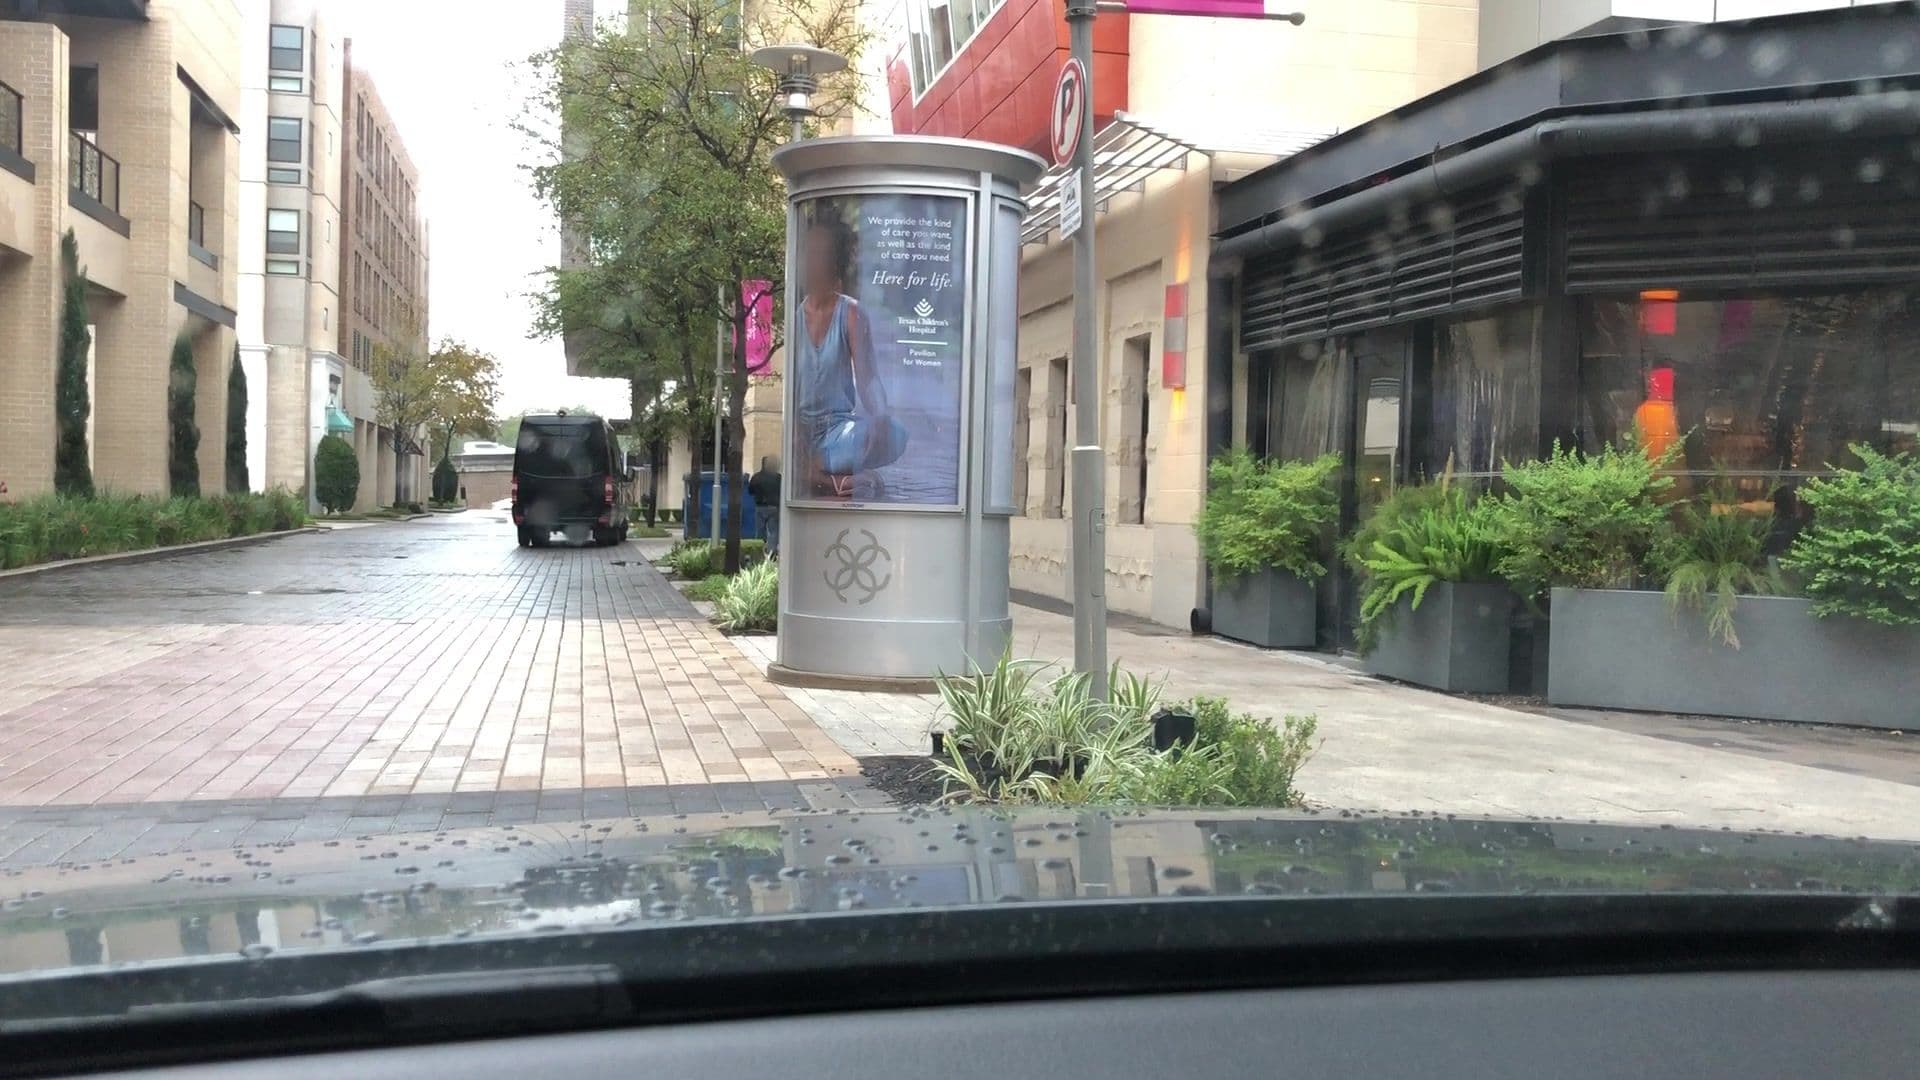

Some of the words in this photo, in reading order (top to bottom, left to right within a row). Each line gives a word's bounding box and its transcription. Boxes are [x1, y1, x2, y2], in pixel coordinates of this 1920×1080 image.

[867, 216, 882, 225] We
[884, 217, 916, 227] provide
[919, 217, 932, 227] the
[934, 218, 952, 228] kind
[881, 228, 890, 236] of
[912, 231, 928, 239] you
[887, 240, 905, 248] well
[906, 241, 915, 249] as
[934, 241, 951, 250] kind
[880, 250, 890, 259] of
[891, 252, 910, 260] care
[911, 254, 928, 262] you
[871, 270, 905, 285] Here
[904, 270, 927, 290] for
[930, 271, 953, 292] life.
[898, 316, 916, 325] Texas
[917, 317, 949, 326] Children's
[908, 325, 936, 335] Hospital
[909, 348, 936, 357] Pavilion
[903, 358, 914, 366] for
[914, 358, 942, 367] Women
